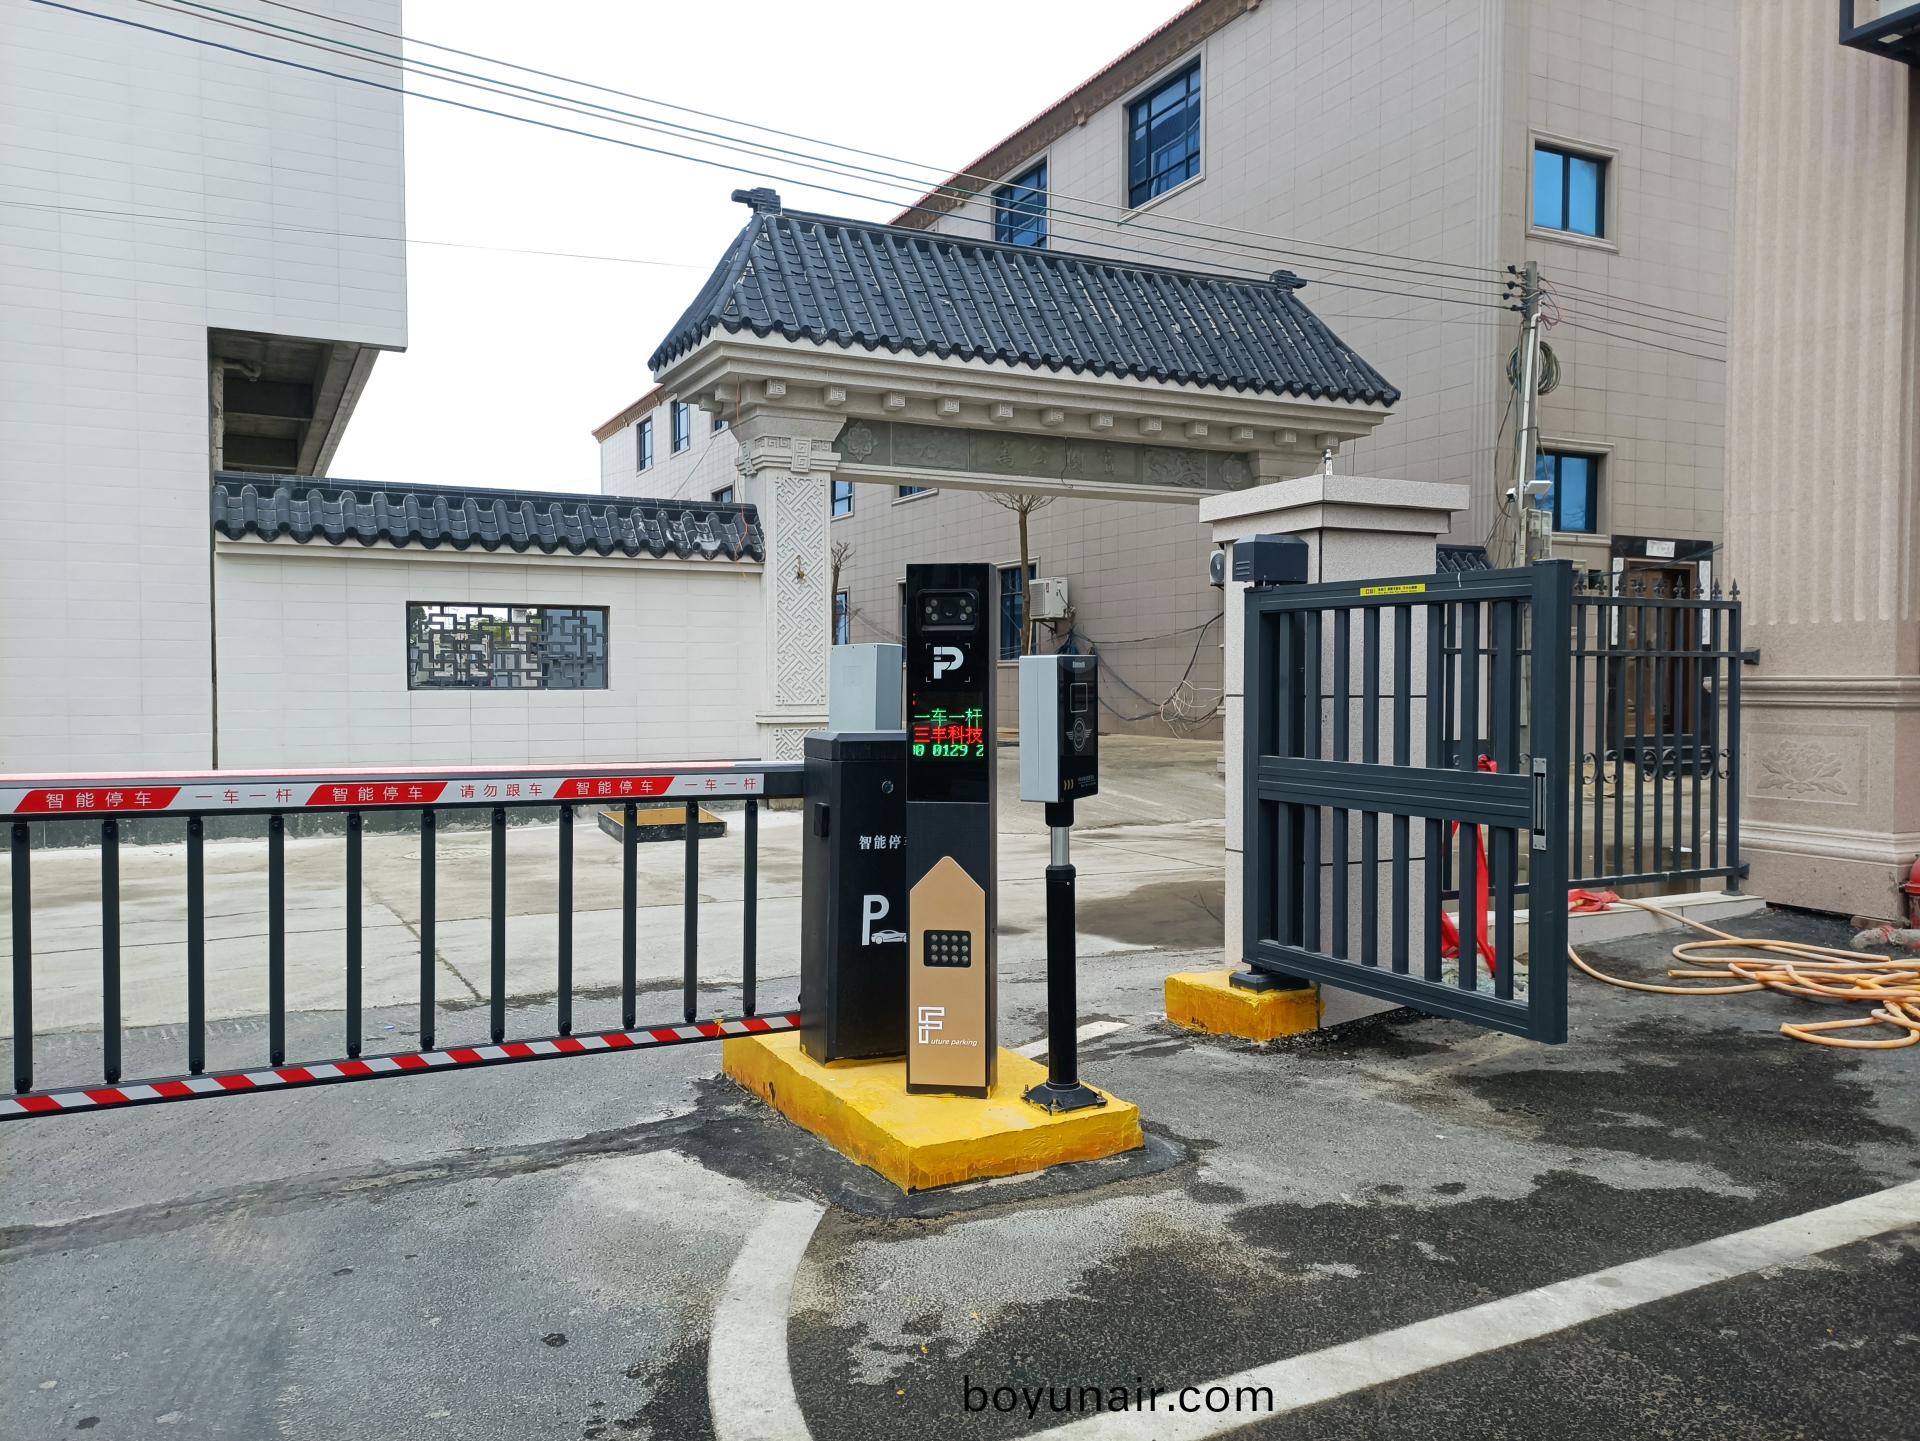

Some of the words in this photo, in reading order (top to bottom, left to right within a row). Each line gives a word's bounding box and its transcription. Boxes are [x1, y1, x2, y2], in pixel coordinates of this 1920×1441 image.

[933, 646, 964, 679] P
[913, 707, 983, 728] 一车一杆
[913, 726, 983, 744] 三丰科技
[932, 744, 968, 757] 0129
[45, 791, 152, 809] 智能停车
[195, 788, 292, 804] 一车一杆
[332, 785, 423, 802] 智能停车
[460, 783, 543, 799] 请勿跟车
[576, 780, 654, 795] 智能停车
[684, 777, 756, 791] 一车一杆
[861, 894, 890, 946] P
[951, 1037, 978, 1047] parking
